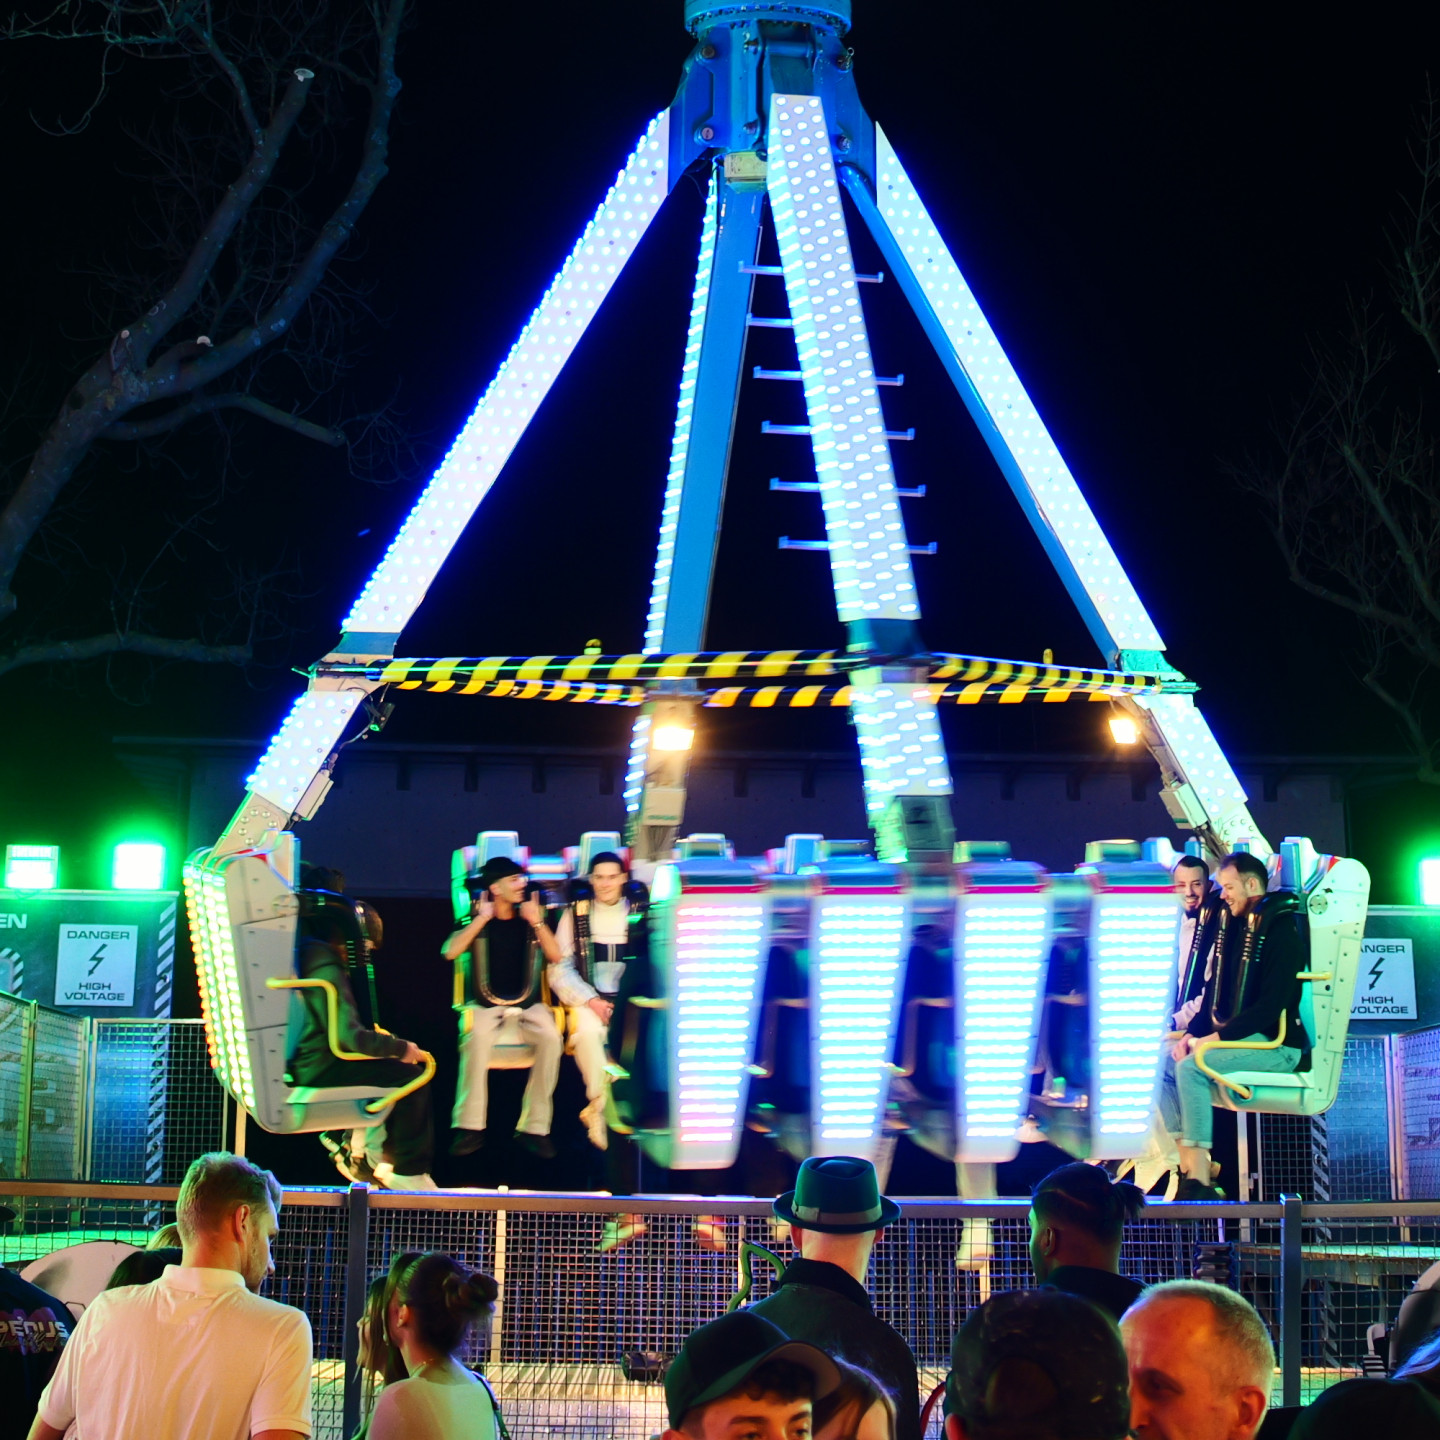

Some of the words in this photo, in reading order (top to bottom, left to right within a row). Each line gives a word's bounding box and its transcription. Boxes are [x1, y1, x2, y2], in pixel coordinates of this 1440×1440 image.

[67, 930, 130, 940] DANGER
[1361, 945, 1405, 953] NGER
[79, 982, 111, 991] HIGH
[64, 992, 125, 1001] VOLTAGE
[1361, 996, 1394, 1004] HIGH
